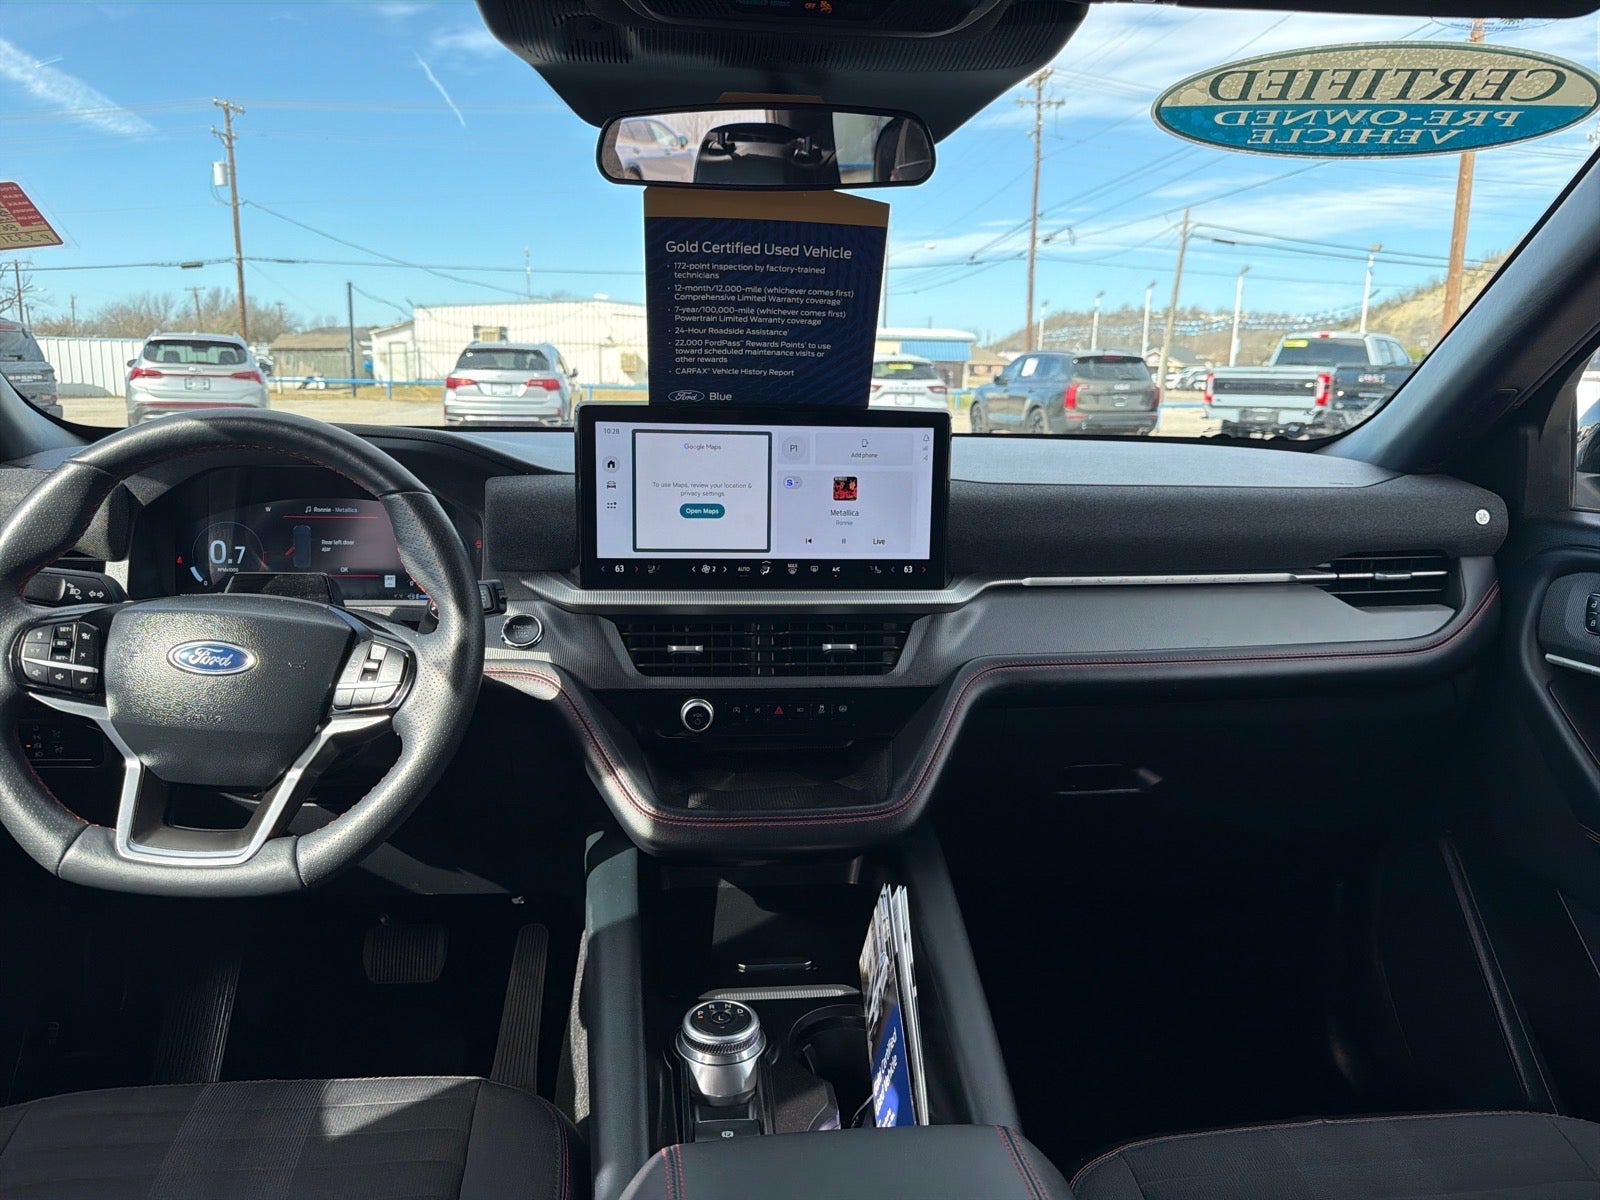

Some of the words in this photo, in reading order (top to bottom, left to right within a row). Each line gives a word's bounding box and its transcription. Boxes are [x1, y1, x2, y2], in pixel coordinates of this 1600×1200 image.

[665, 240, 699, 253] Gold
[702, 241, 761, 255] Certified
[764, 243, 800, 257] Used
[803, 244, 852, 260] Vehicle
[674, 262, 710, 271] 172-point
[711, 262, 753, 272] inspection
[754, 264, 764, 273] by
[766, 264, 826, 275] factory-trained
[674, 271, 720, 279] technicians
[674, 284, 762, 294] 12-month/12,000-mile
[763, 286, 806, 296] (whichever
[807, 289, 834, 297] comes
[835, 289, 855, 299] first)
[674, 293, 736, 302] Comprehensive
[737, 294, 767, 302] Limited
[768, 295, 804, 305] Warranty
[674, 305, 755, 315] 7-year/100,000-mile
[756, 307, 799, 317] (whichever
[800, 310, 826, 318] comes
[827, 309, 847, 319] first)
[674, 314, 718, 322] Powertrain
[718, 315, 748, 323] Limited
[749, 315, 786, 325] Warranty
[674, 326, 707, 334] 24-Hour
[708, 327, 745, 335] Roadside
[674, 339, 703, 347] 22,000
[745, 340, 779, 348] Rewards
[675, 347, 703, 355] toward
[703, 347, 744, 355] scheduled
[744, 348, 795, 357] maintenance
[795, 349, 815, 357] visits
[711, 367, 739, 375] Vehicle
[740, 368, 768, 377] History
[768, 368, 795, 377] Report
[709, 392, 733, 401] Blue
[683, 442, 705, 451] Google
[705, 443, 721, 451] Maps
[672, 481, 688, 489] Maps,
[680, 490, 701, 498] privacy
[702, 490, 725, 498] settings
[685, 507, 702, 516] Open
[702, 507, 720, 516] Maps
[830, 508, 859, 517] Metallica
[872, 538, 886, 546] Live
[209, 540, 246, 565] 0.7
[614, 564, 625, 573] 63
[903, 565, 913, 573] 63
[188, 646, 235, 668] Ford
